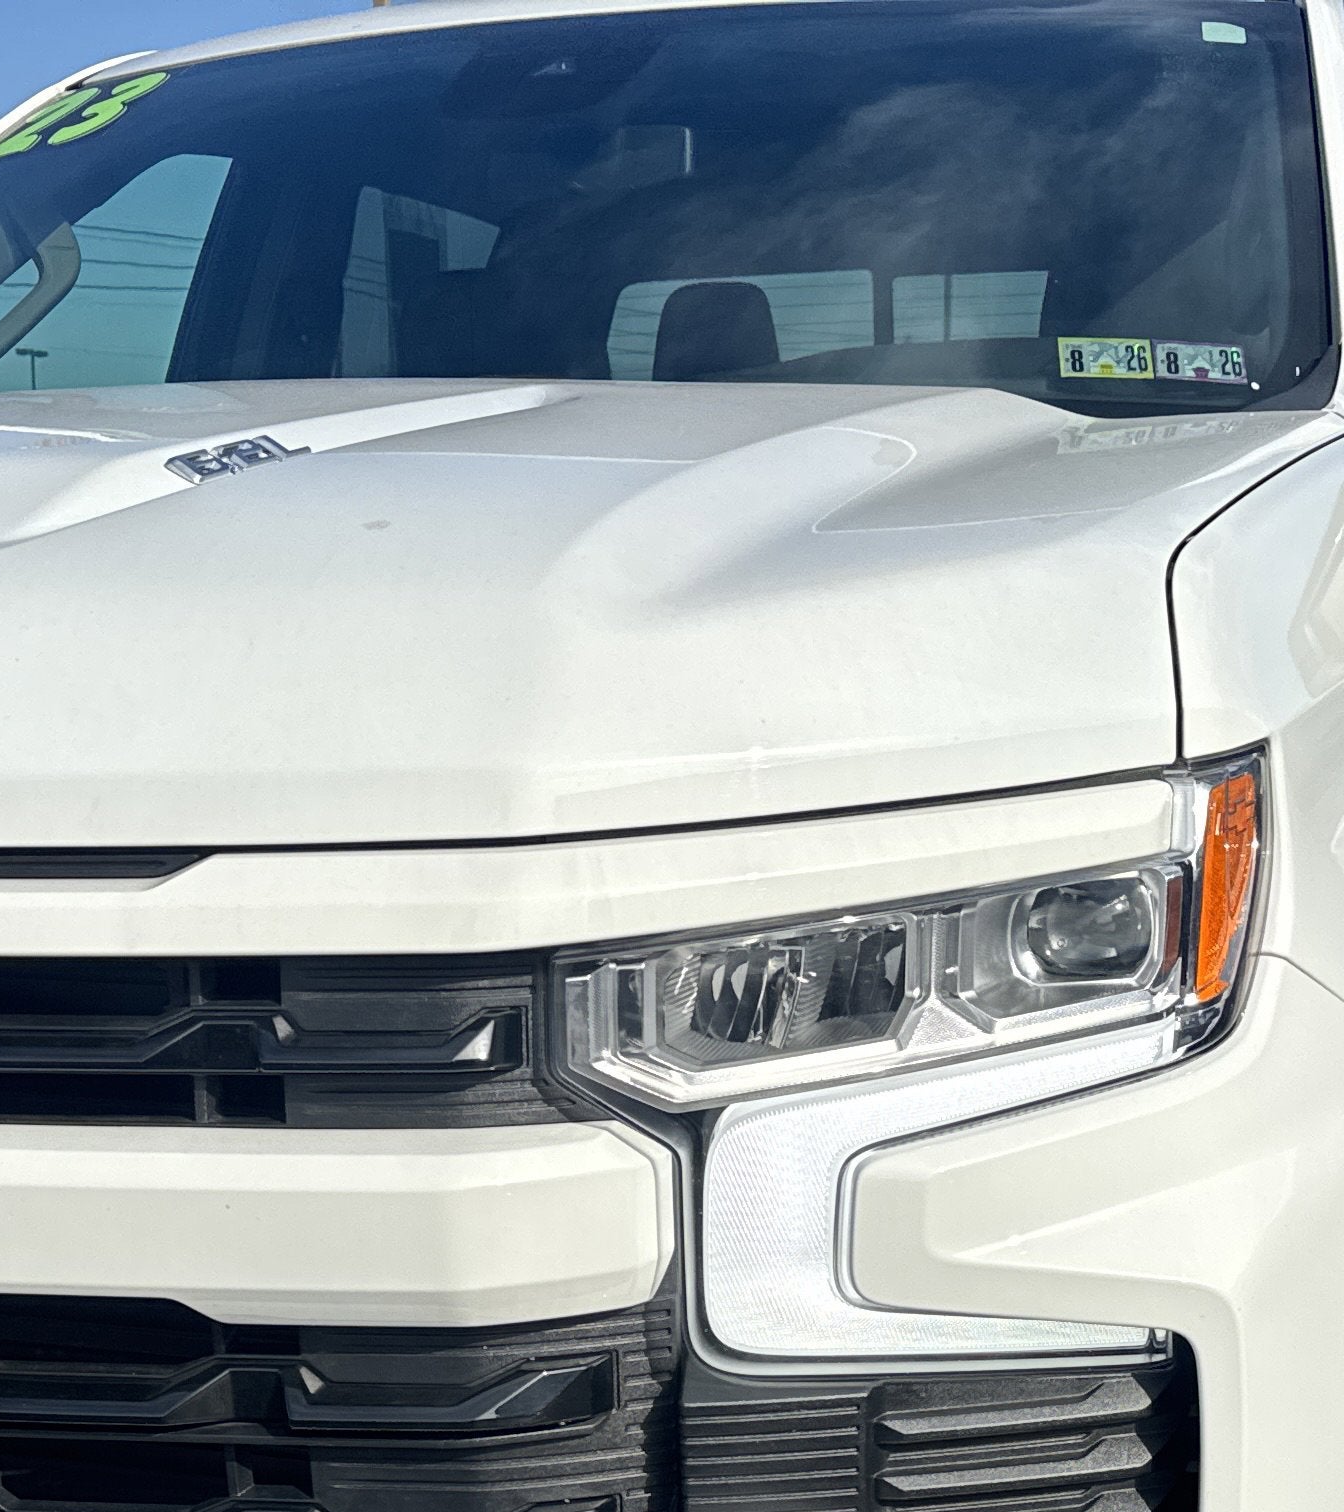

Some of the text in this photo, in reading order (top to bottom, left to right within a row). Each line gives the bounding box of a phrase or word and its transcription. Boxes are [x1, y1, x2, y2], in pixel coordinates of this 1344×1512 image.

[1070, 343, 1149, 373] 8 26
[1165, 348, 1244, 377] 8 26
